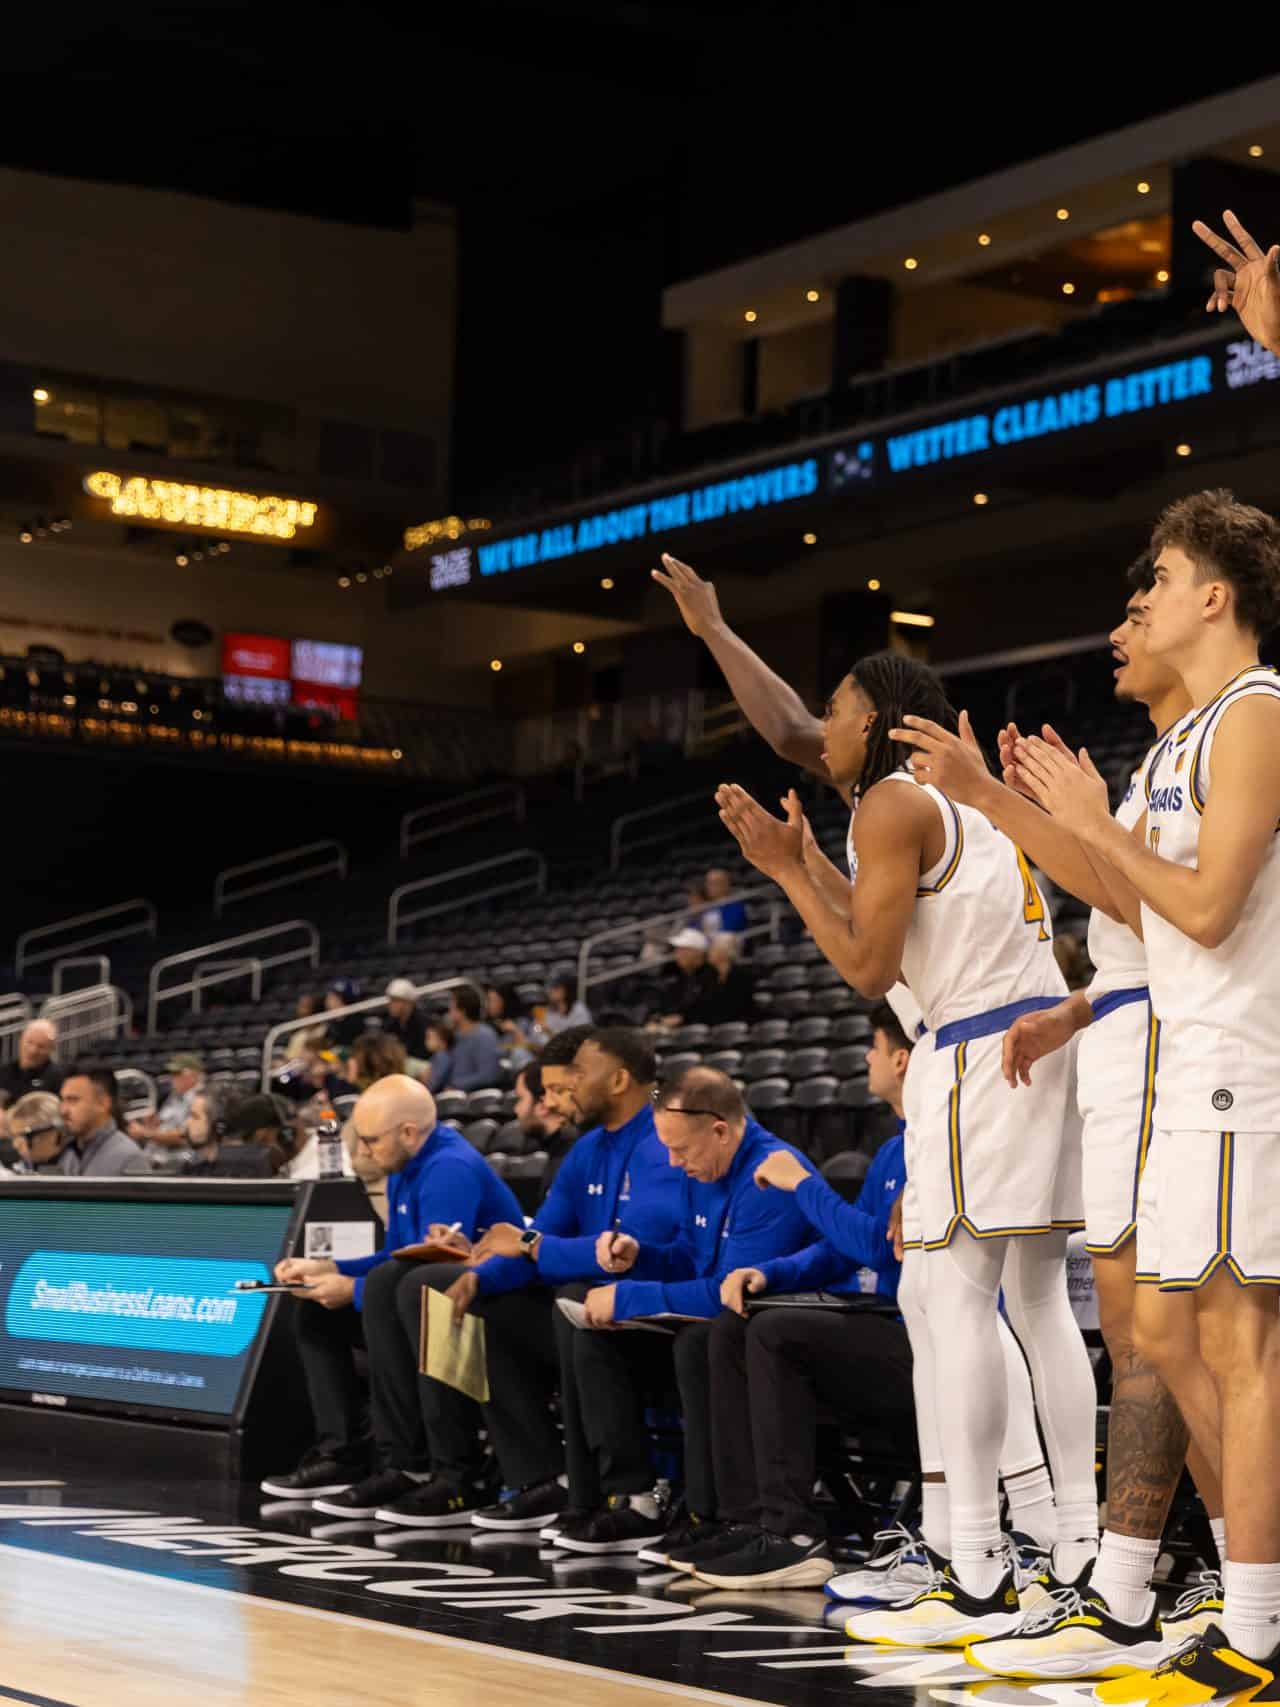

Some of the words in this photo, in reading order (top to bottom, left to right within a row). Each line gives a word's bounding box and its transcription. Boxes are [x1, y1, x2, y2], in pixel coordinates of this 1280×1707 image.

[886, 414, 991, 473] WETTER
[993, 384, 1101, 445] CLEANS
[1105, 355, 1213, 418] BETTER
[650, 491, 690, 534] THE
[693, 459, 817, 521] LEFTOVERS
[20, 1515, 839, 1634] MERCURY
